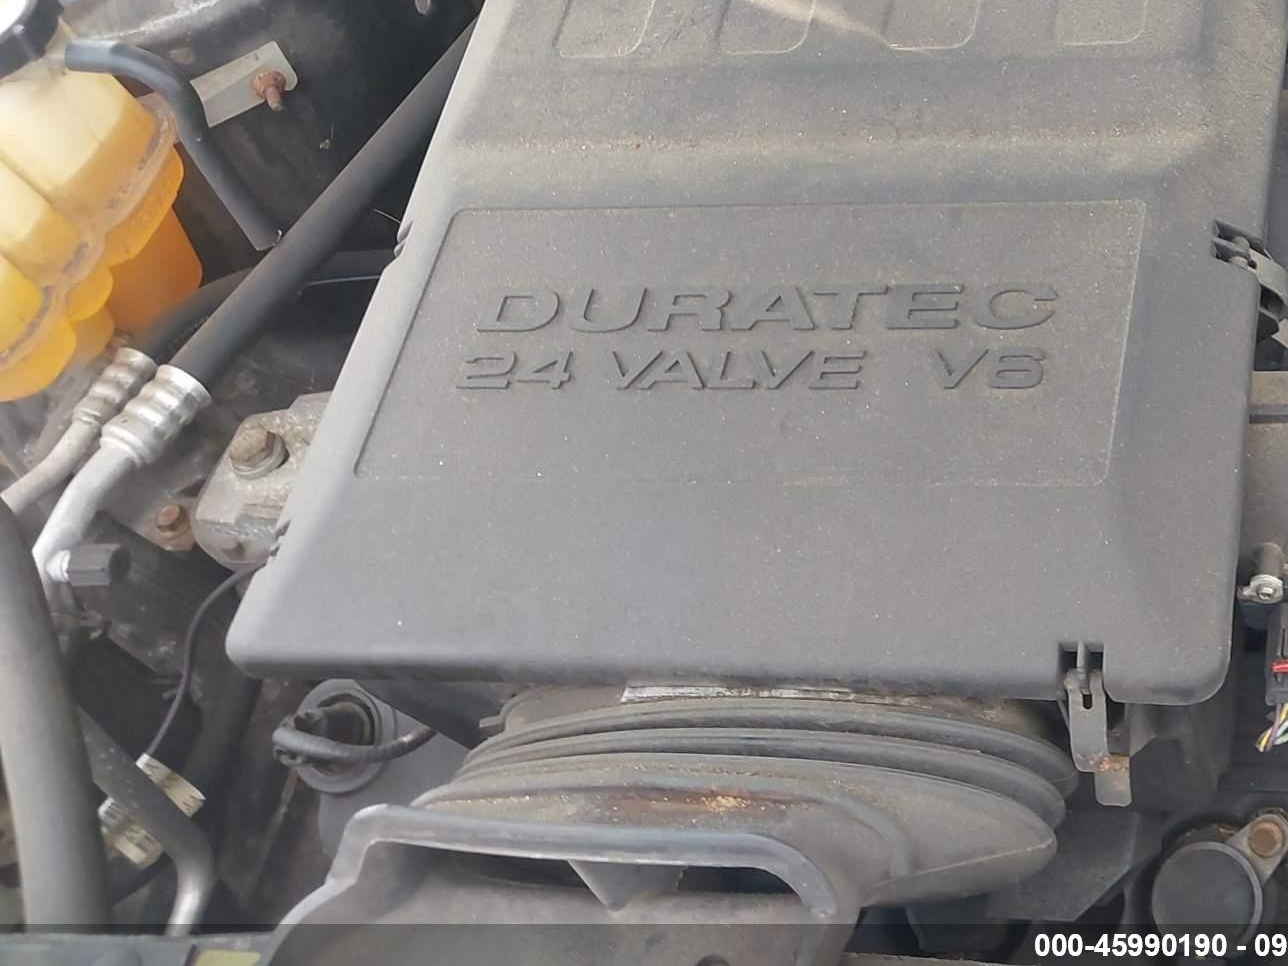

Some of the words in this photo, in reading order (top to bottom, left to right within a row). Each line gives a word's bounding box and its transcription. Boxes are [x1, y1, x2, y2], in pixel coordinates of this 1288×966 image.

[476, 284, 1059, 333] DURATEC
[456, 348, 574, 390] 24
[609, 347, 867, 390] VALVE
[934, 347, 1049, 390] V6
